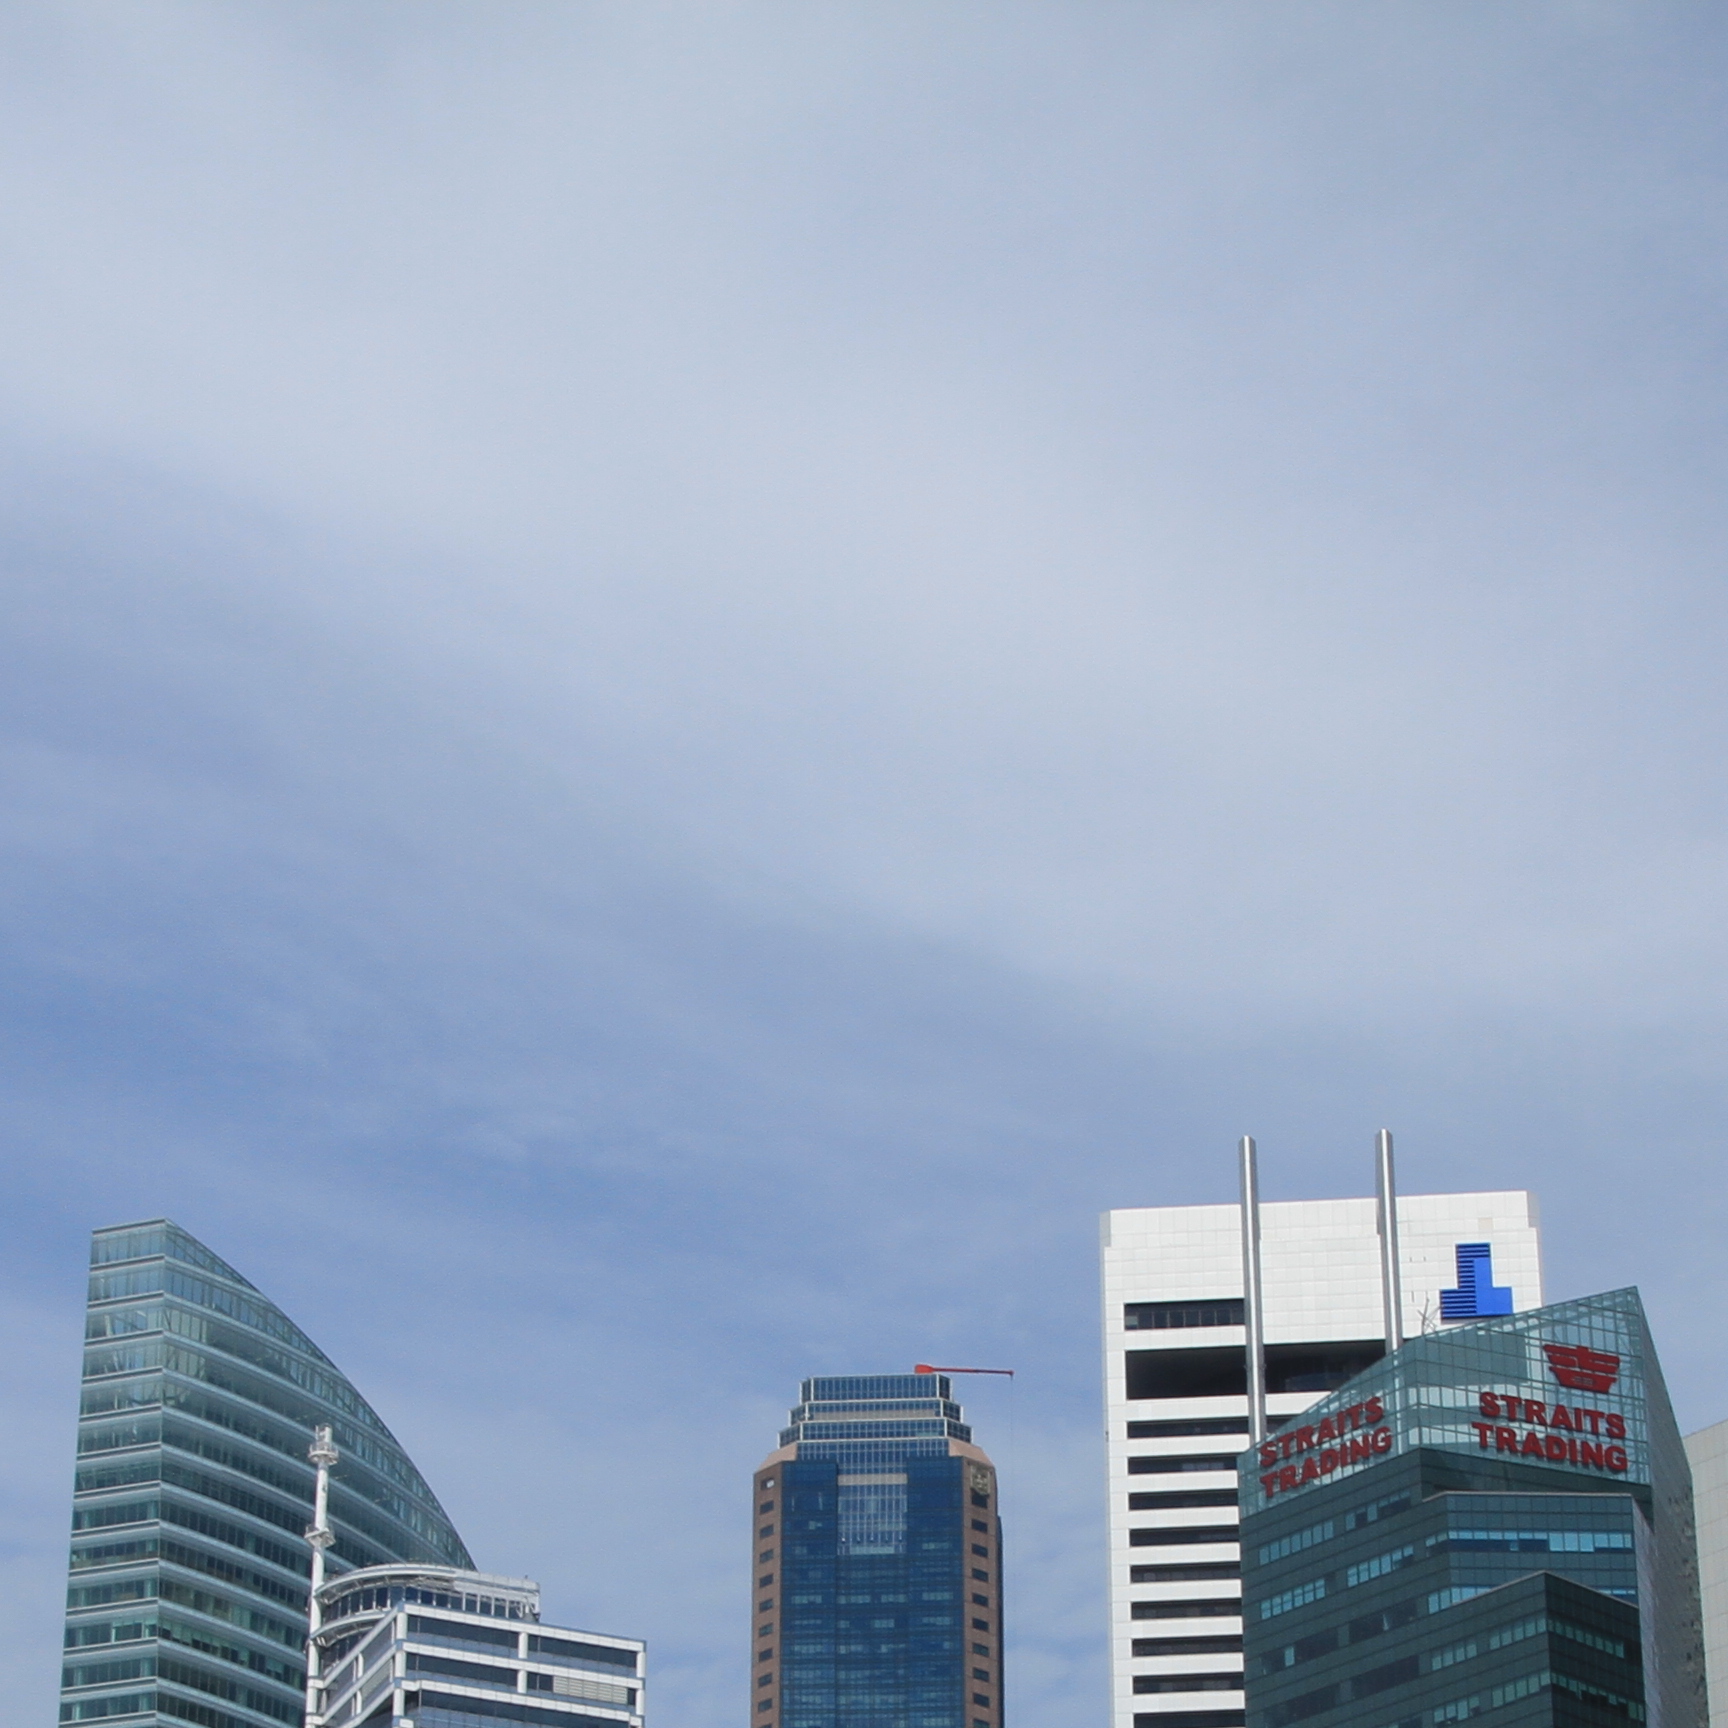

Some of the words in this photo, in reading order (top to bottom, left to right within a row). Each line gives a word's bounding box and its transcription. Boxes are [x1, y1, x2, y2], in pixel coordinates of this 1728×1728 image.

[1259, 1396, 1384, 1468] STRAITS
[1479, 1391, 1626, 1440] STRAITS
[1260, 1425, 1393, 1498] TRADING
[1472, 1421, 1629, 1473] TRADING
